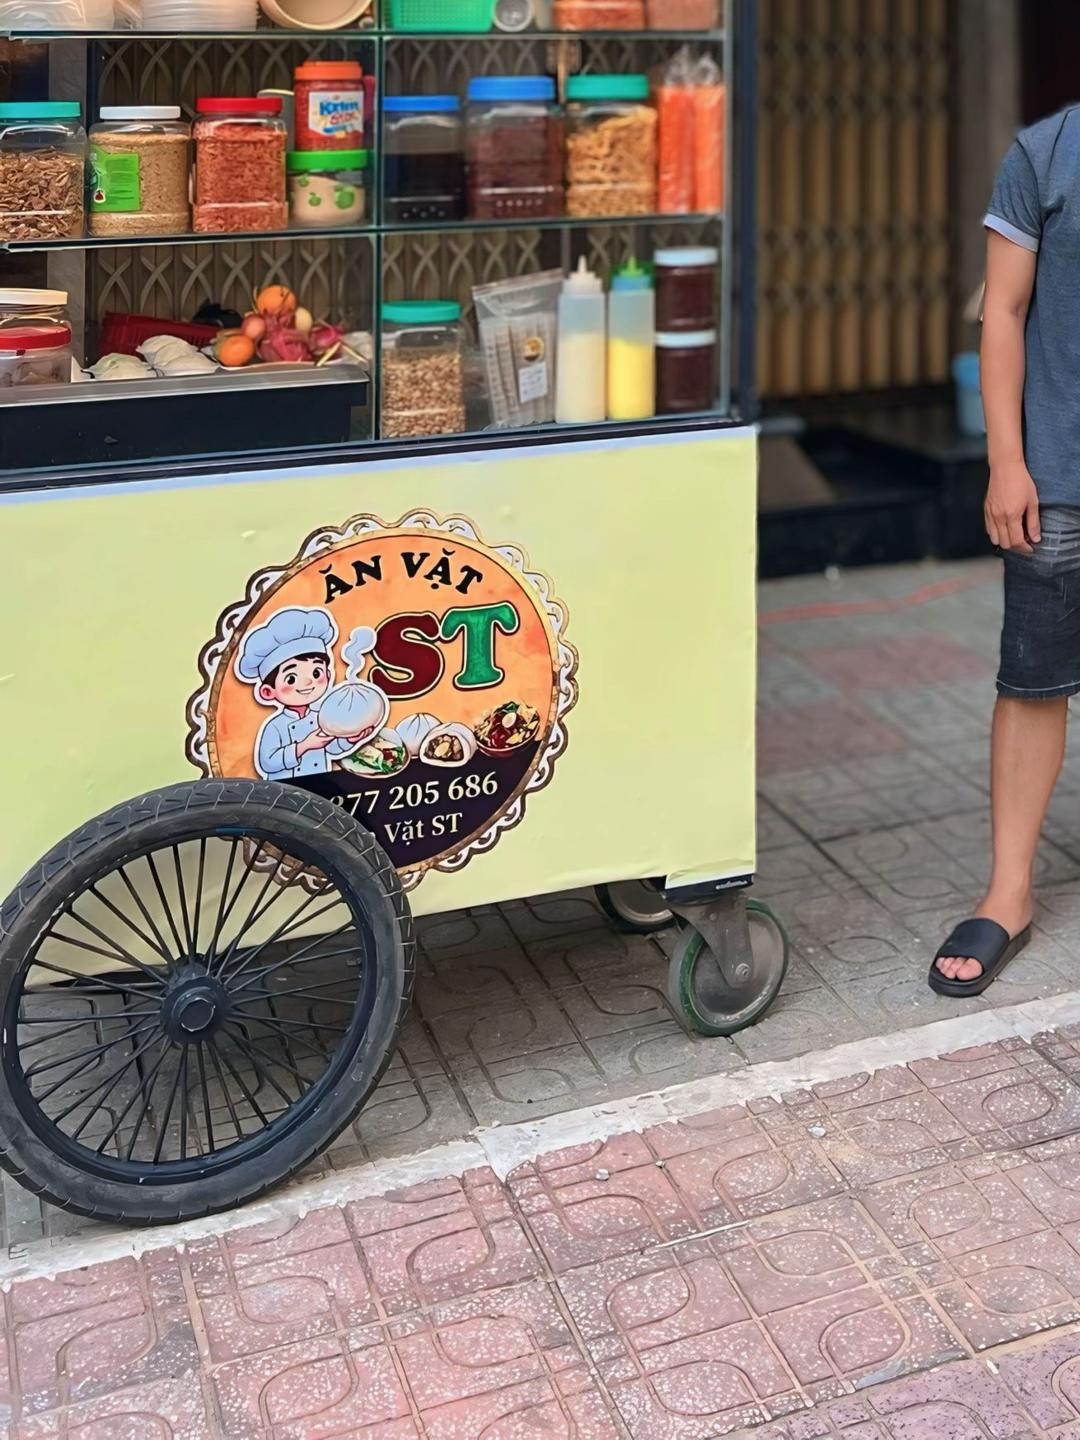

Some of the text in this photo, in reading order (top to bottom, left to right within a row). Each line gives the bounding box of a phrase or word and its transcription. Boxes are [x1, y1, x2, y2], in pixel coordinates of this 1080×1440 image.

[318, 547, 484, 605] ĂN VẶT
[368, 599, 521, 702] ST
[388, 780, 440, 811] 205
[447, 770, 499, 801] 686
[383, 812, 463, 846] Vặt ST
